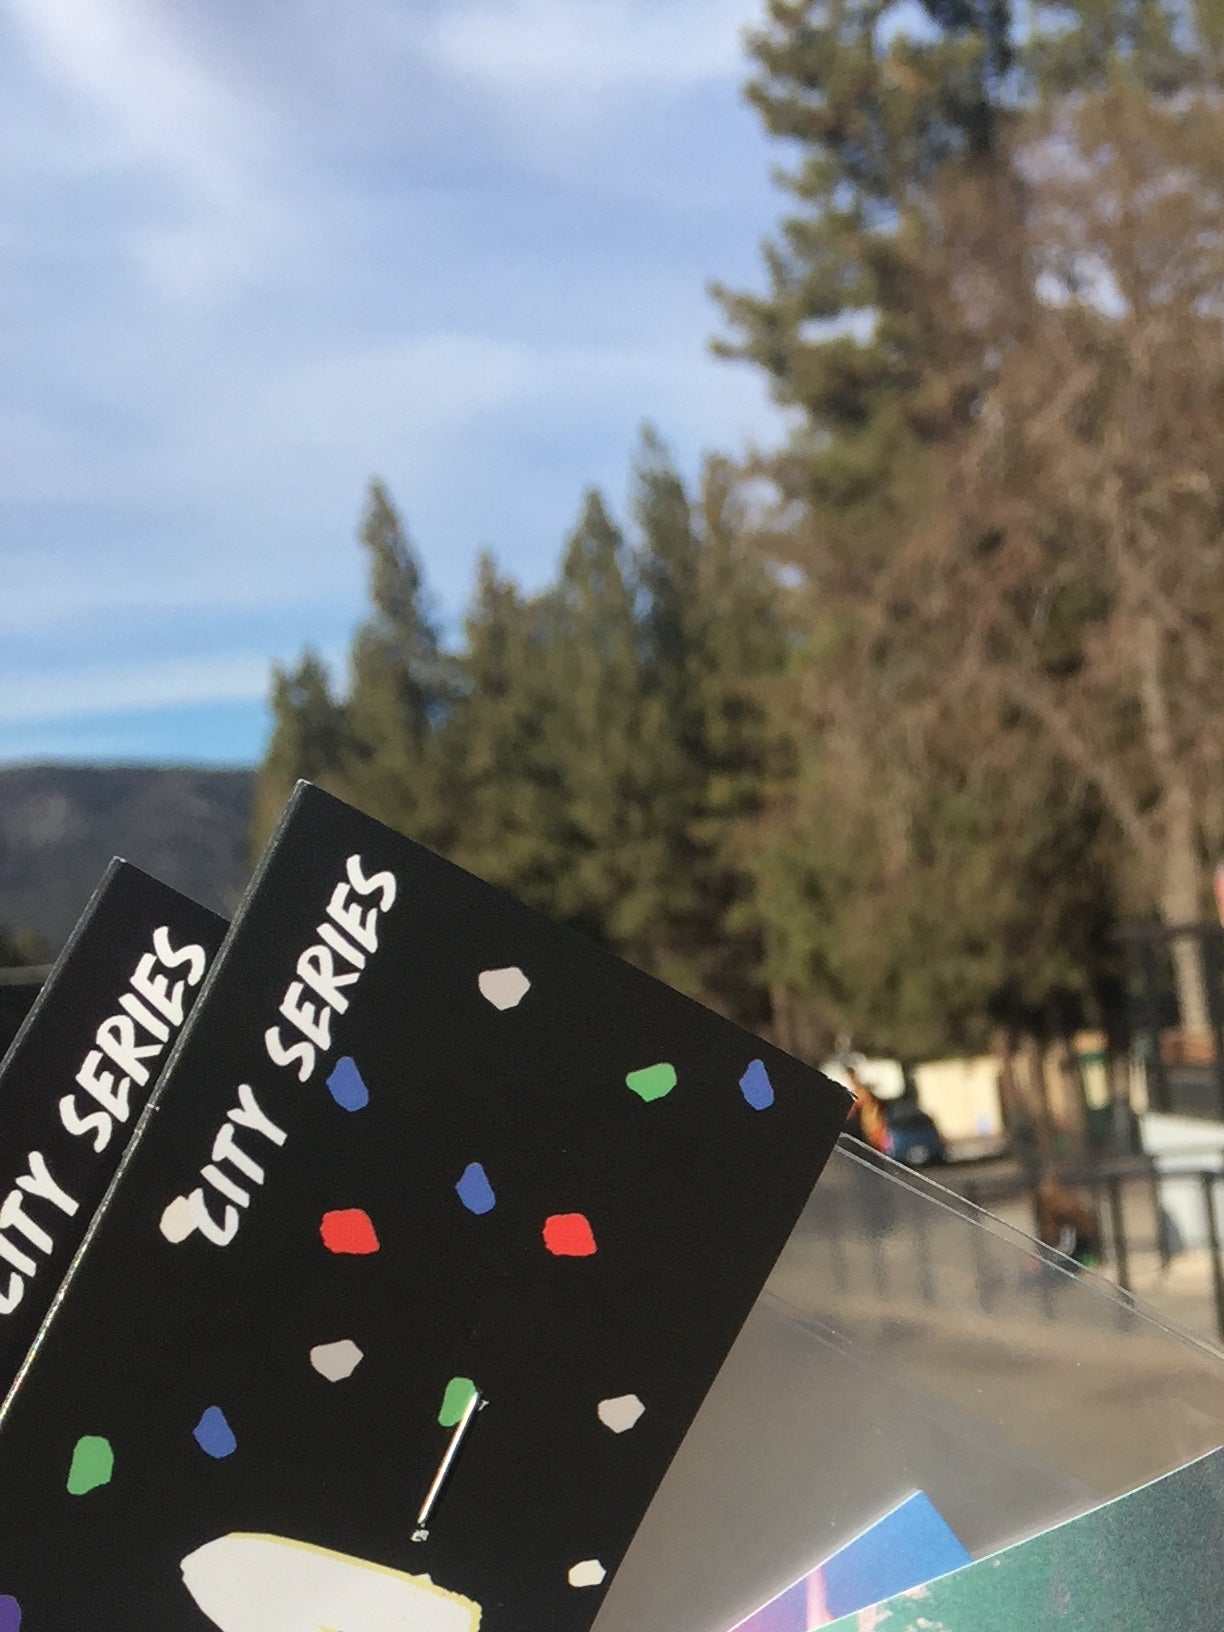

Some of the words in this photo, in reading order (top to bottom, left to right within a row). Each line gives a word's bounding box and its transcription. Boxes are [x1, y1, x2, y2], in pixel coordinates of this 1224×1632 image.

[59, 925, 206, 1153] SERIES
[186, 1083, 288, 1247] CITY
[264, 854, 397, 1083] SERIES
